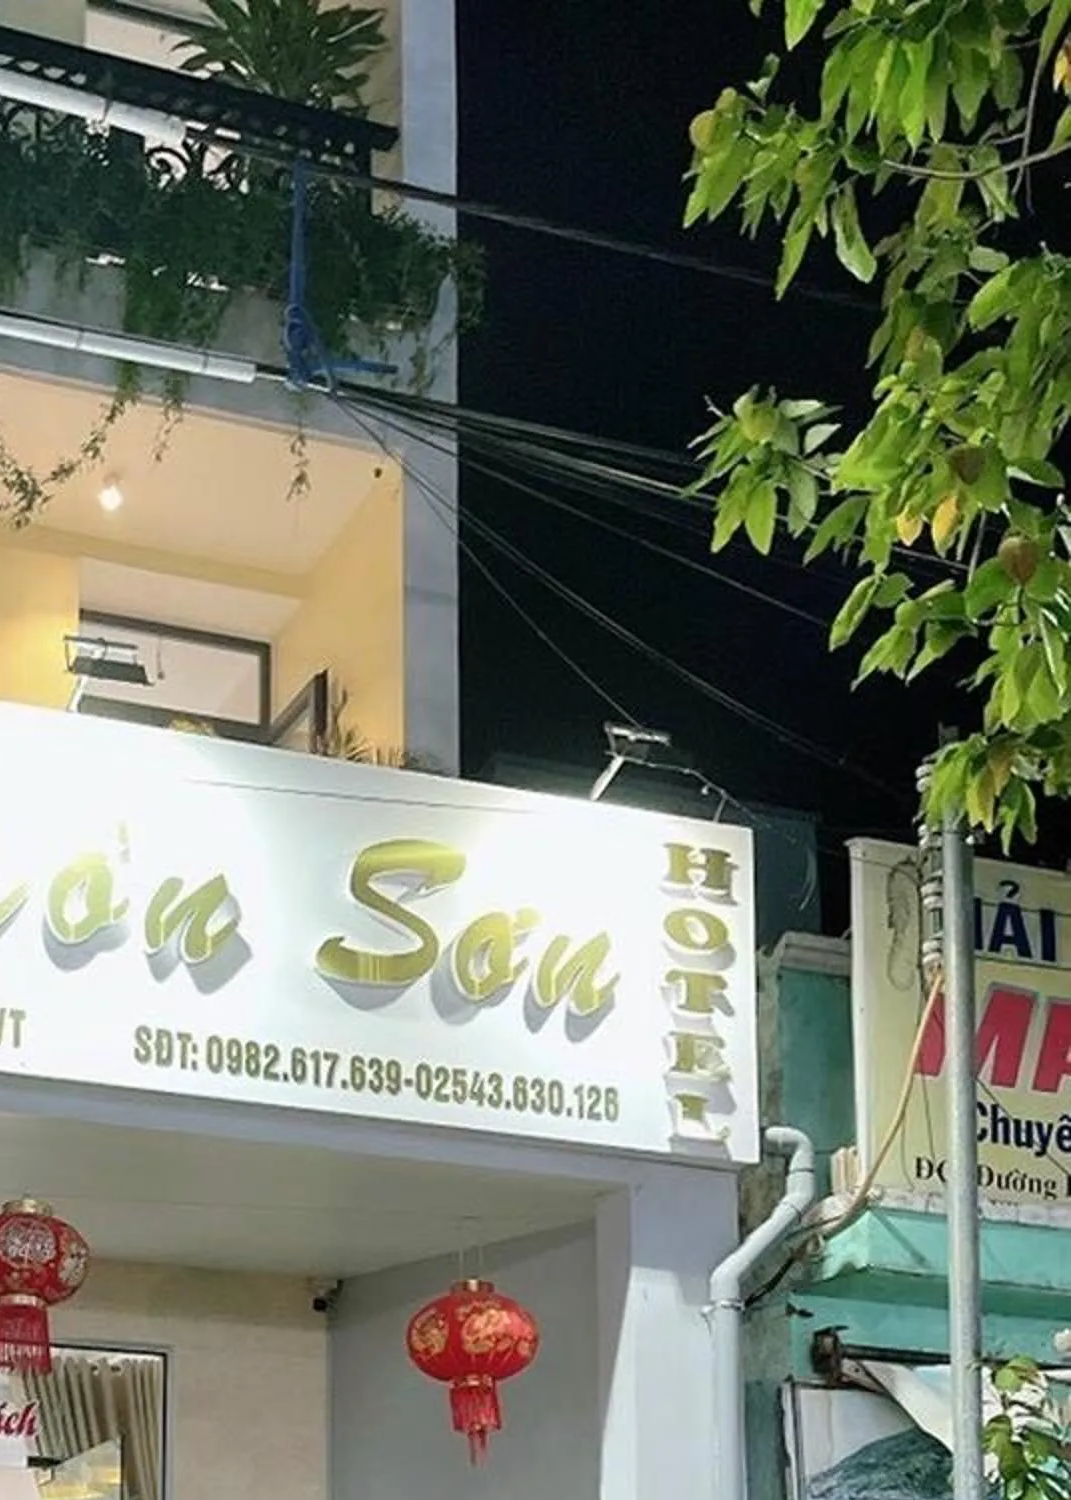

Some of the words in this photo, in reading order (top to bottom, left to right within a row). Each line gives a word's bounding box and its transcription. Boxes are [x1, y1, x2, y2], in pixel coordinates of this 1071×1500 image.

[316, 838, 620, 1016] Sơn
[663, 843, 733, 1140] HOTEL
[134, 1025, 198, 1071] SĐT:
